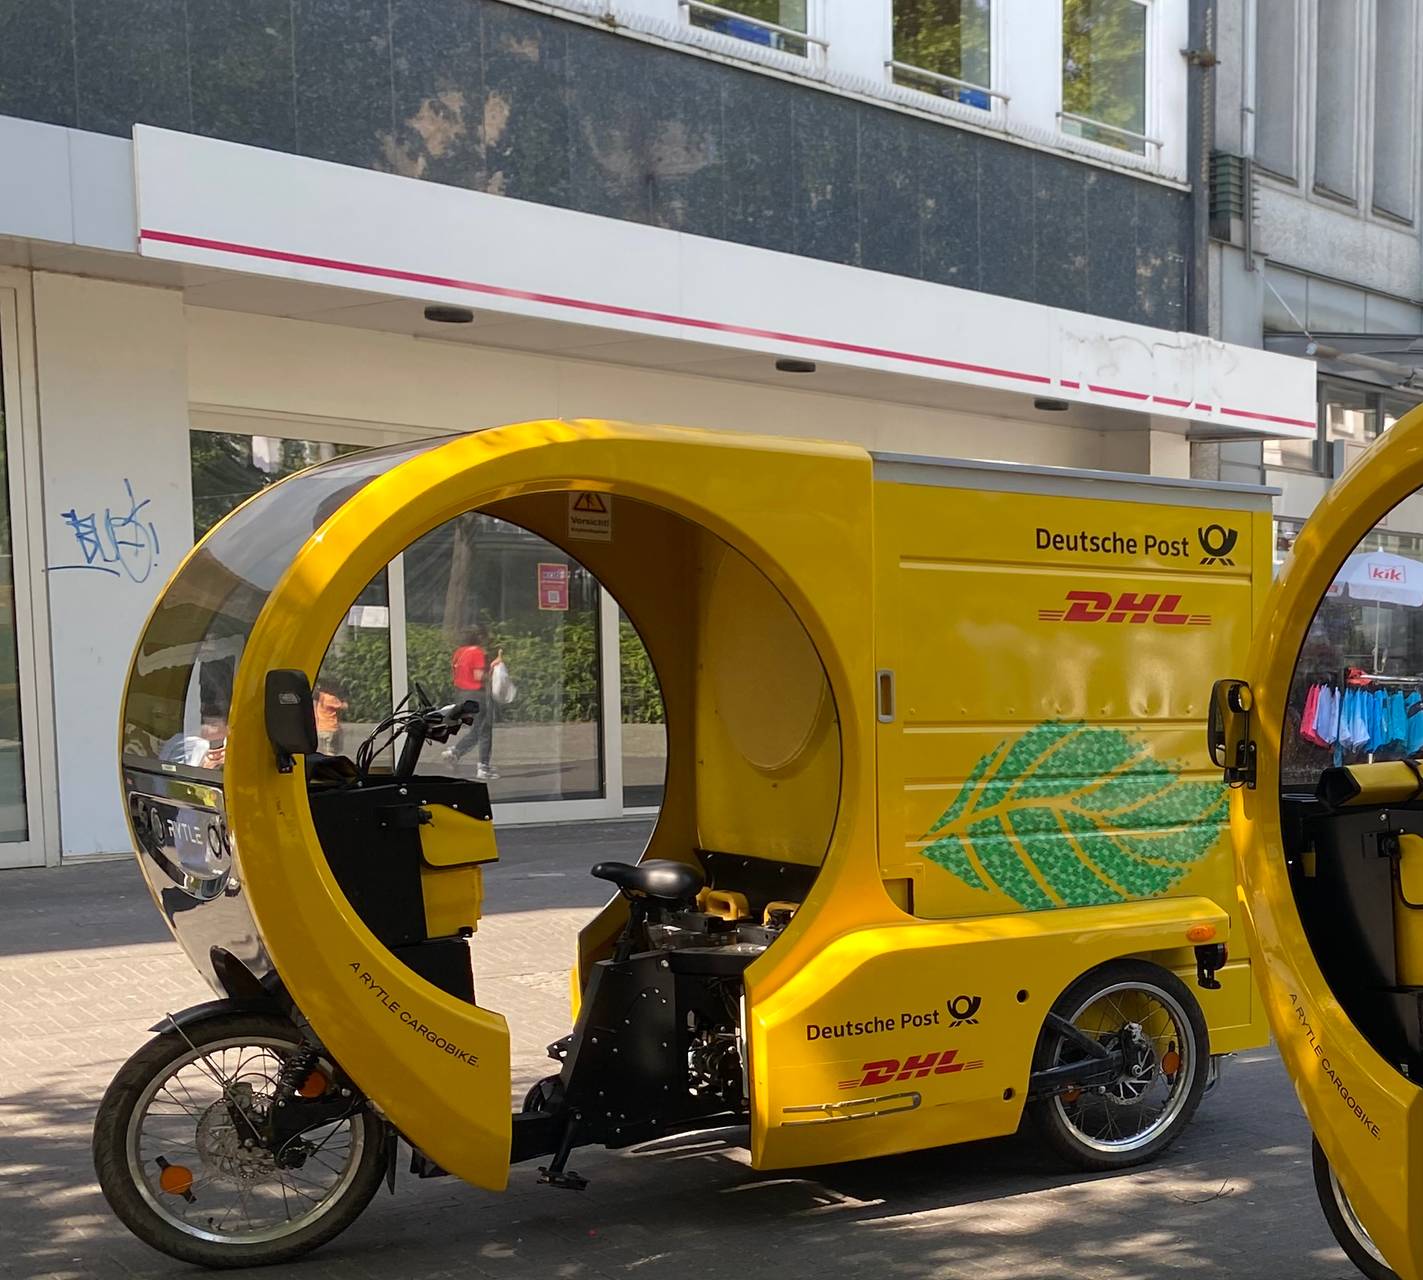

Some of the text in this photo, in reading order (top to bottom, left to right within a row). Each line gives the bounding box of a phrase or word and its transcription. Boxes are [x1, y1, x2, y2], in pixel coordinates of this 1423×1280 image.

[1036, 527, 1190, 557] Deutsche Post
[1372, 567, 1401, 581] kik
[1063, 590, 1190, 625] DHL
[166, 819, 204, 845] RYTLE
[349, 962, 361, 973] A
[359, 972, 400, 1013] RYTLE
[806, 1010, 940, 1041] Deutsche Post
[1289, 993, 1298, 1005] A
[1295, 1006, 1323, 1057] RYTLE
[859, 1049, 965, 1087] DHL
